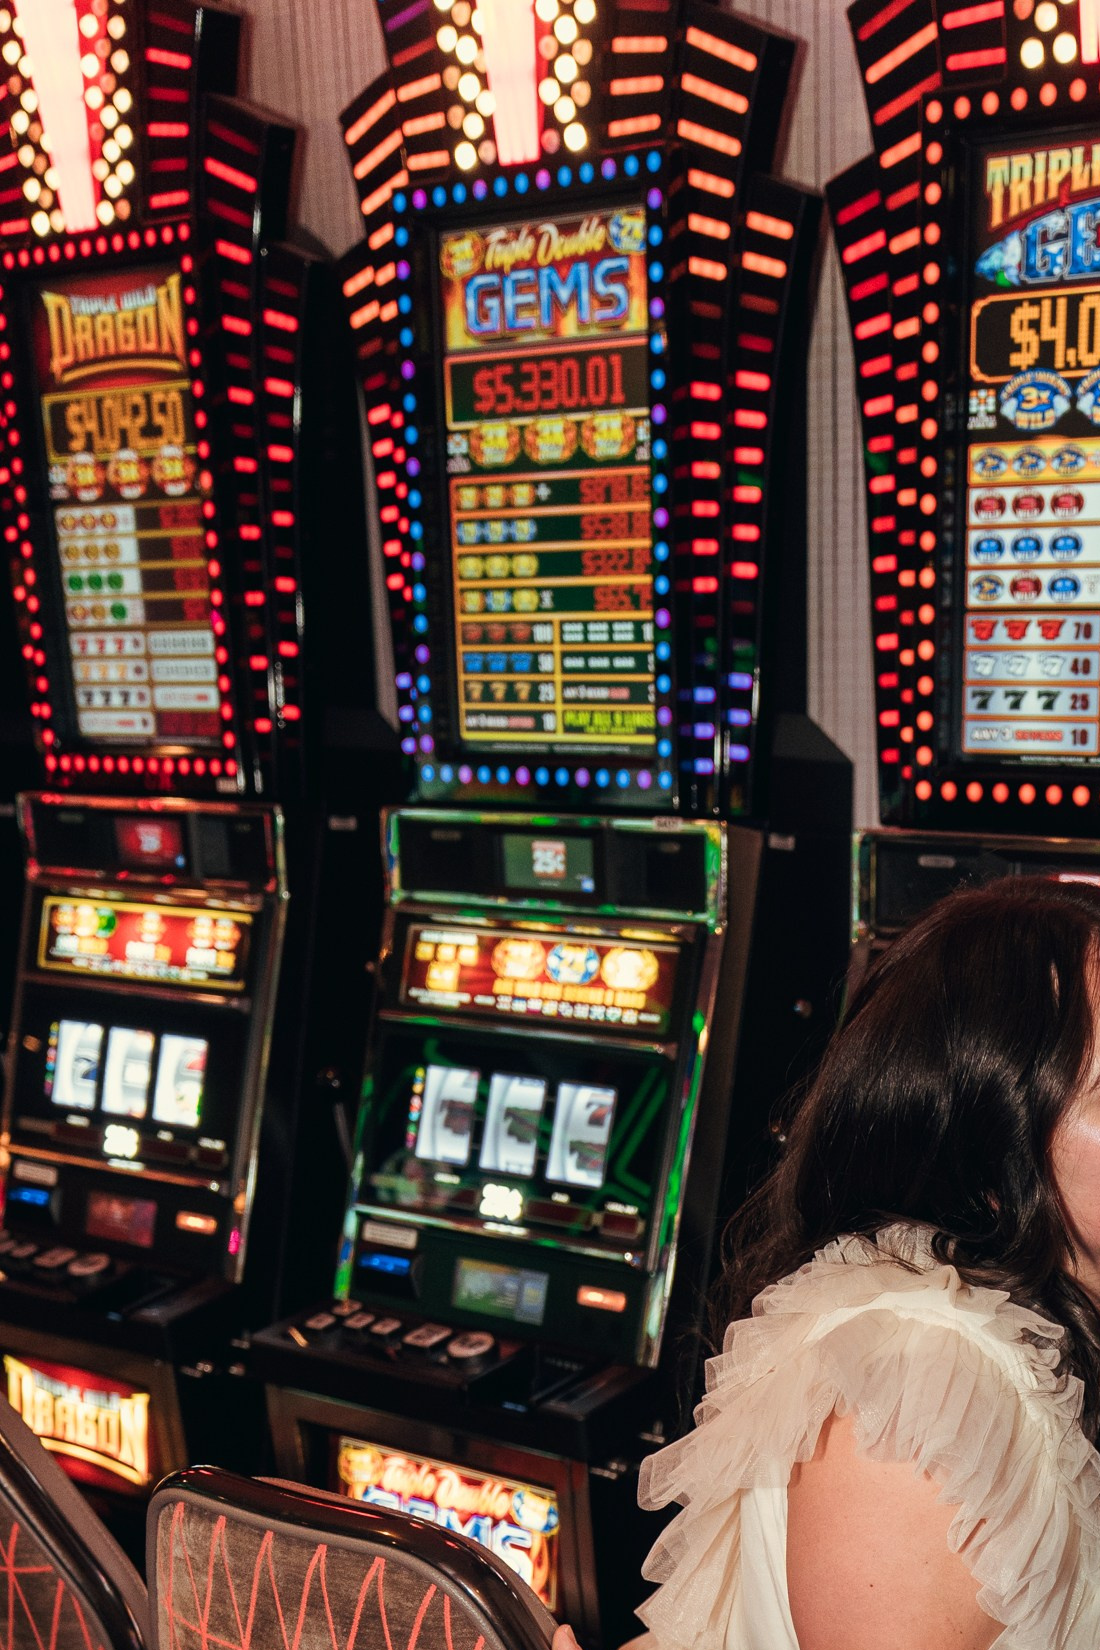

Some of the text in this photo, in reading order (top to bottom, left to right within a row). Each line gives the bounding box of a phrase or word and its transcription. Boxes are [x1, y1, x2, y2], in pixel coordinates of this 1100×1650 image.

[464, 257, 630, 336] GEMS
[41, 273, 186, 384] DRAGON
[472, 353, 626, 415] $5,330.01
[1074, 622, 1093, 640] 70
[1070, 658, 1090, 675] 40
[971, 690, 1089, 711] 7 7 7 25
[1071, 729, 1088, 745] 10
[3, 1354, 150, 1486] DRAGON
